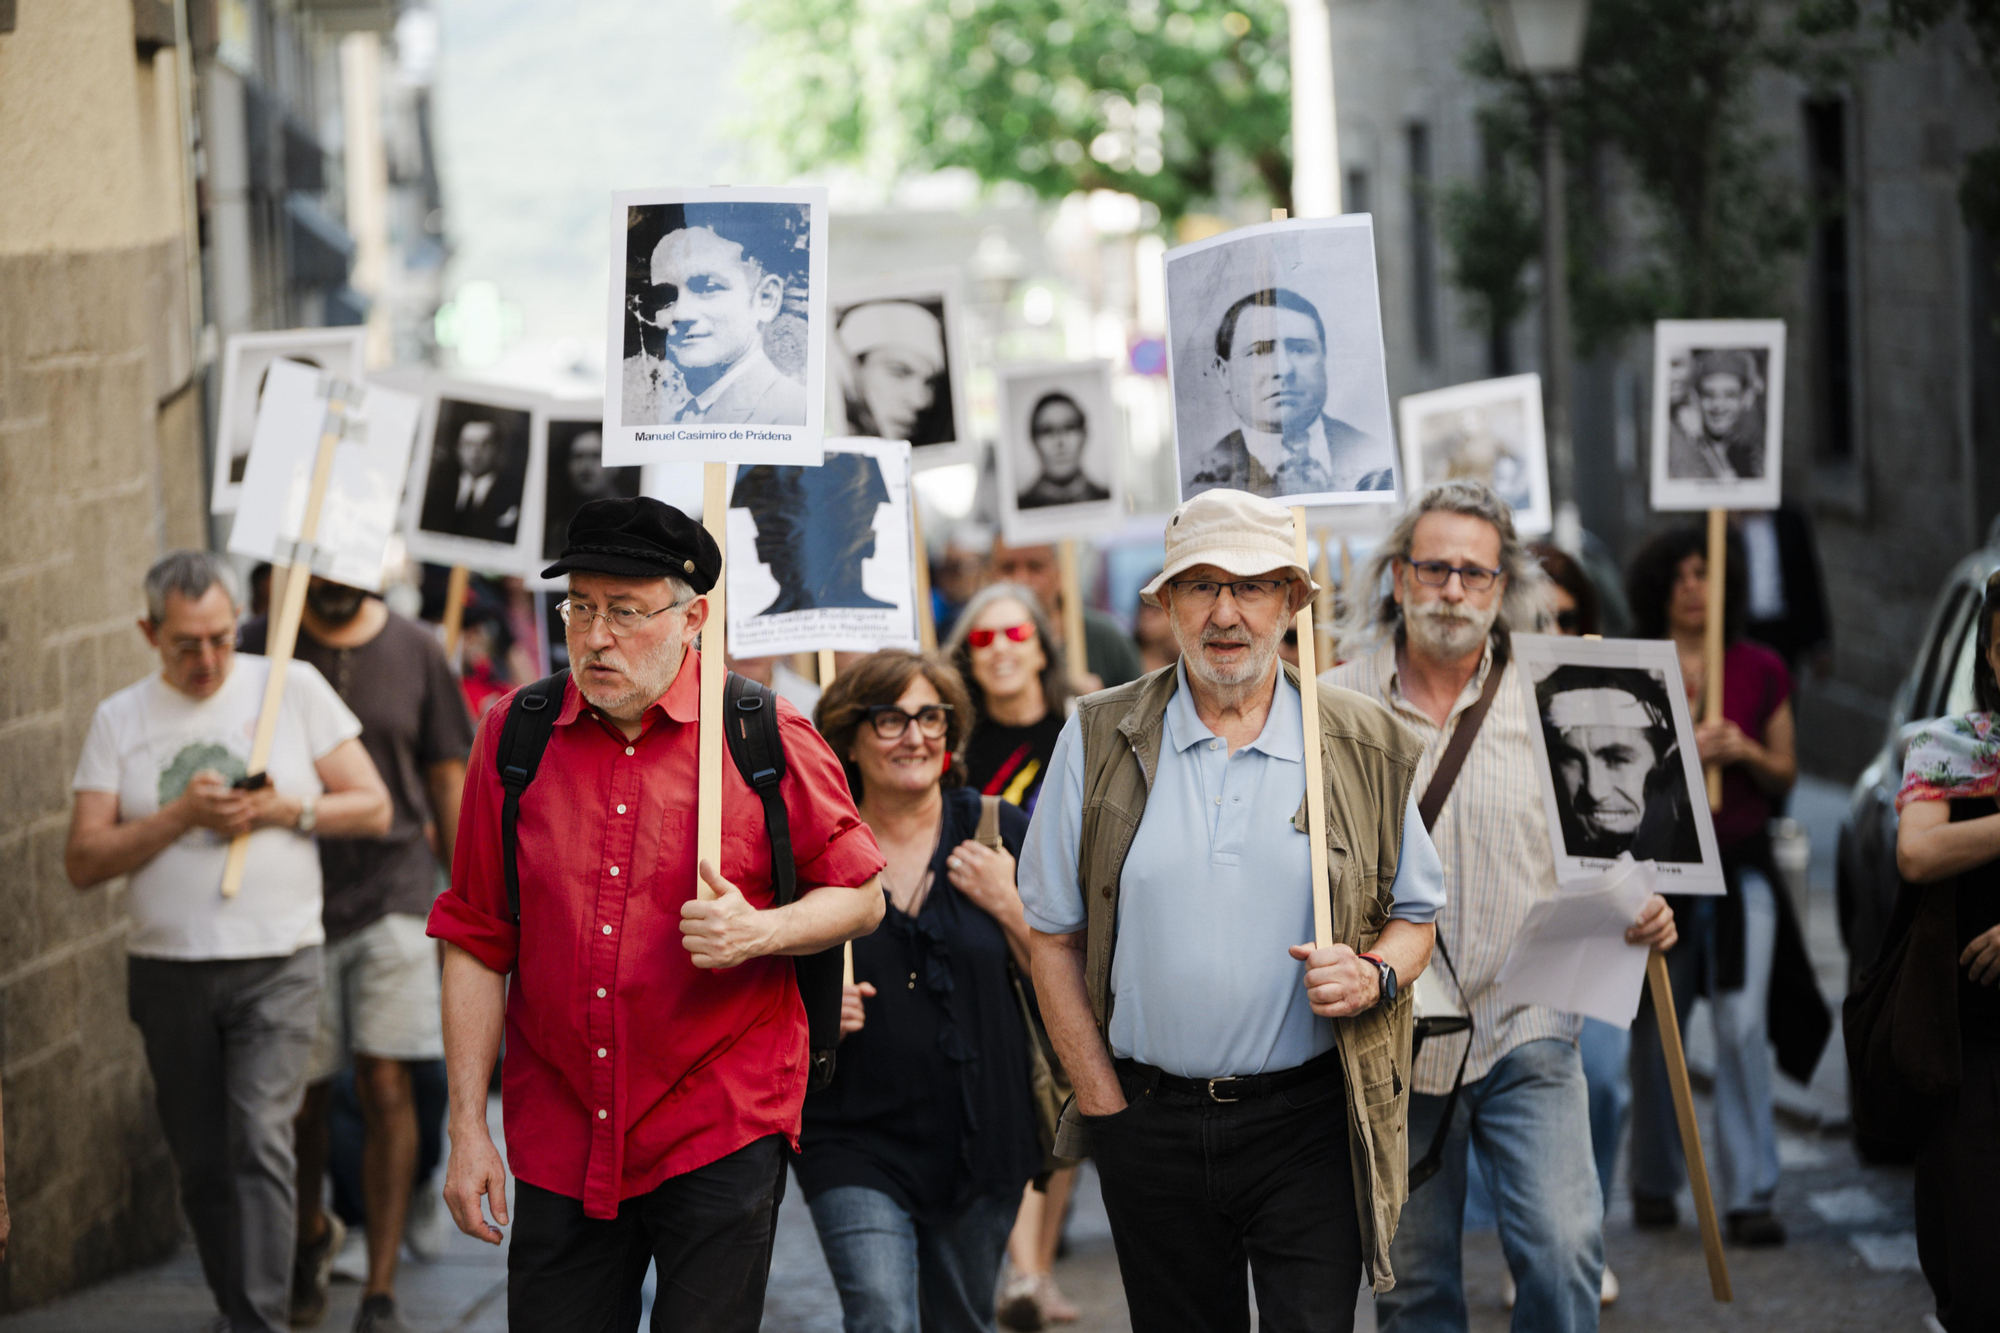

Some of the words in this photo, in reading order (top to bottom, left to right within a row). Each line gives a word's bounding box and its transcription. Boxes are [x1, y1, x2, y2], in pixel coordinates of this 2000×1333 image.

[635, 431, 675, 441] Manuel
[677, 430, 727, 440] Casimiro
[729, 430, 743, 440] de
[746, 430, 792, 441] Prádena
